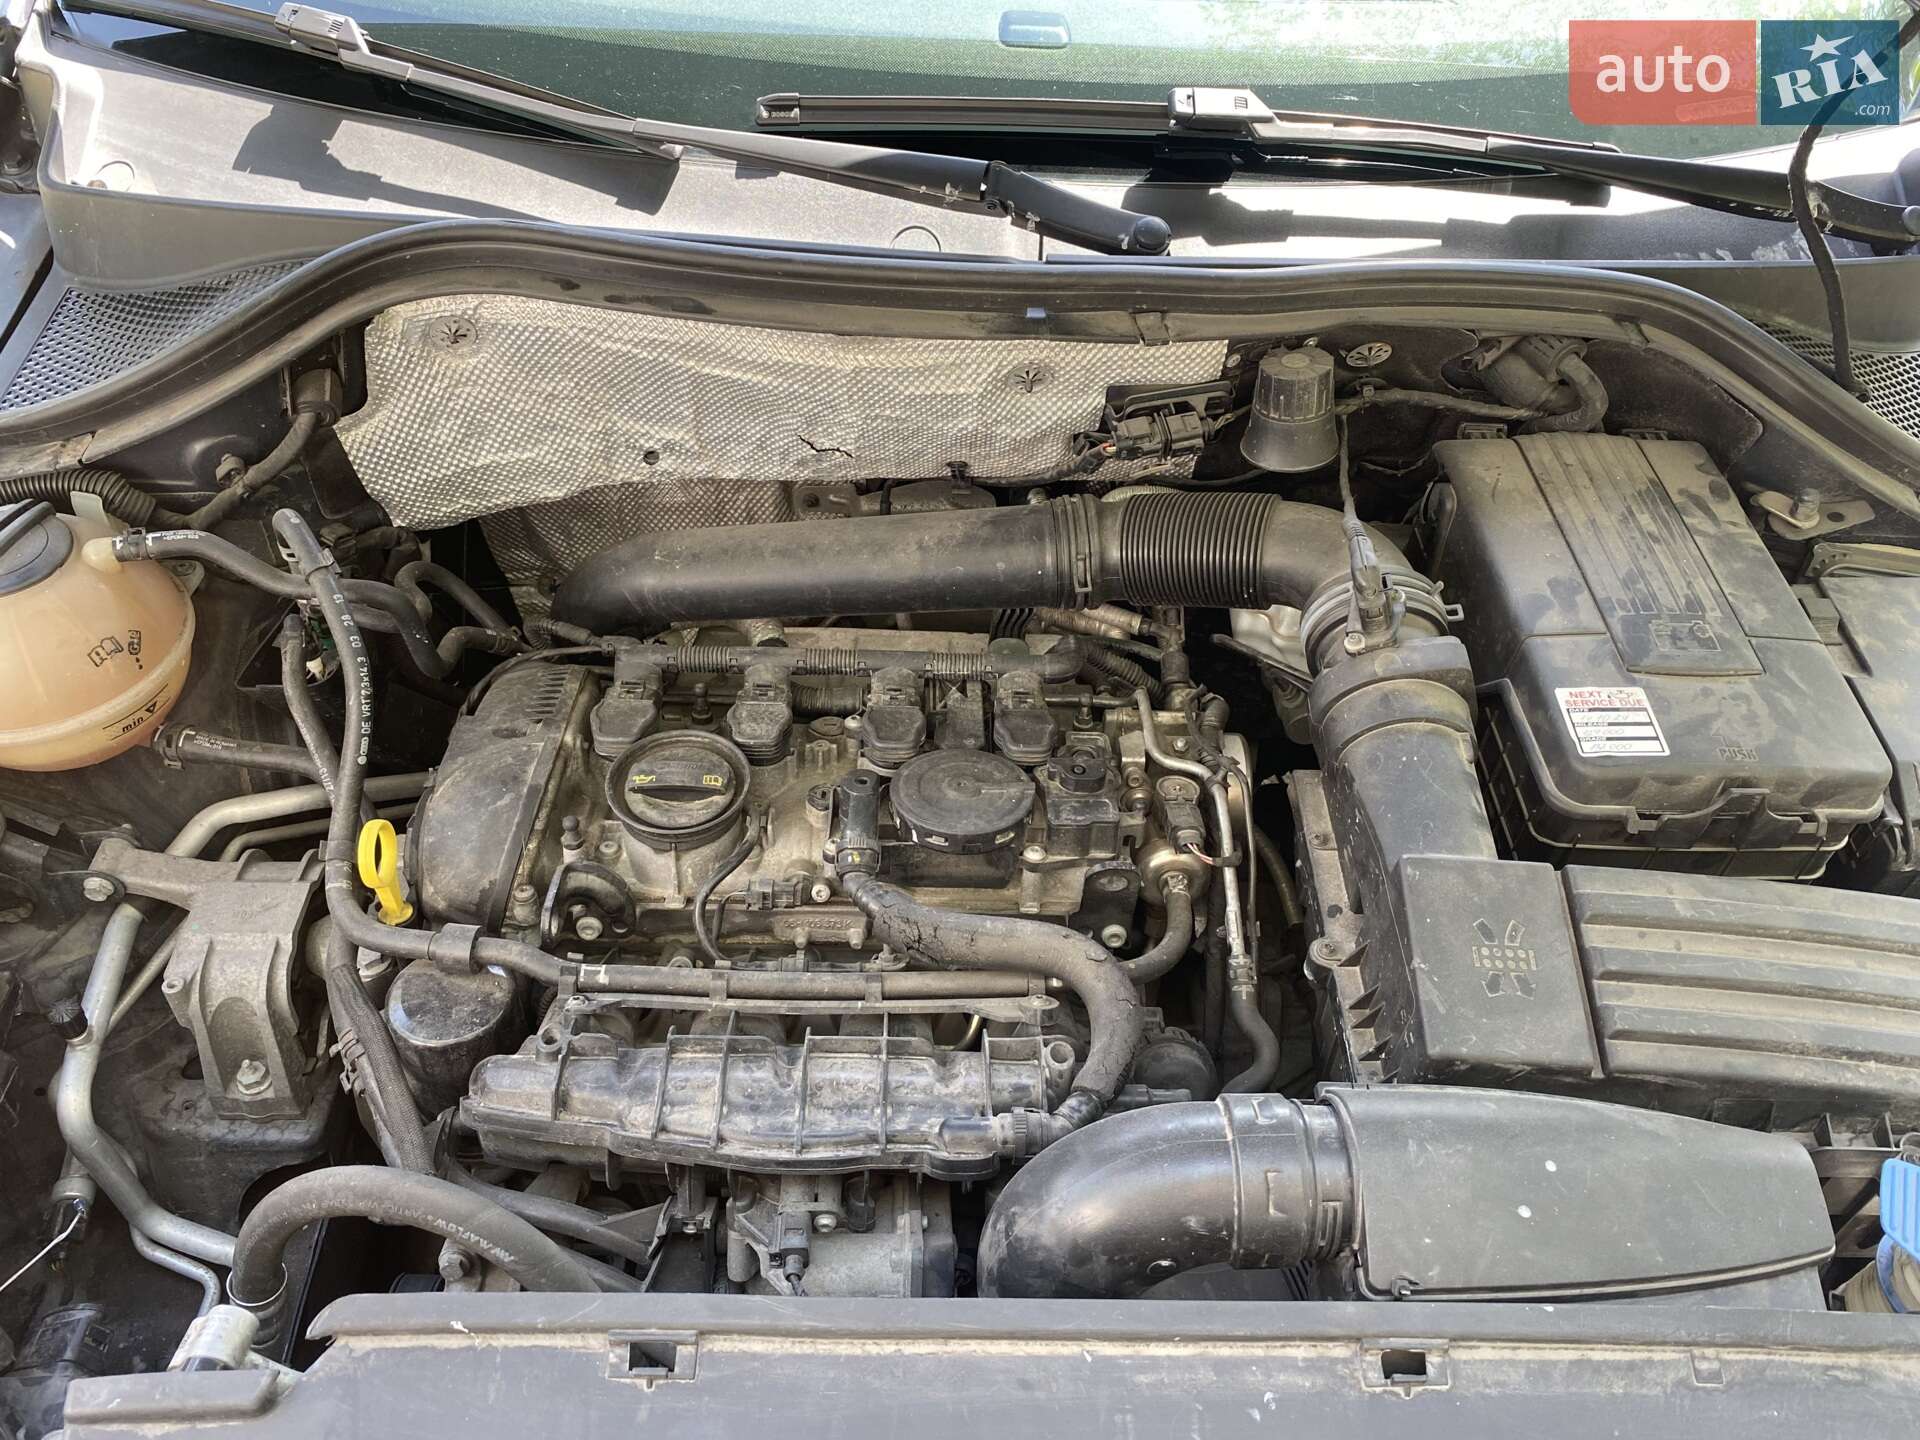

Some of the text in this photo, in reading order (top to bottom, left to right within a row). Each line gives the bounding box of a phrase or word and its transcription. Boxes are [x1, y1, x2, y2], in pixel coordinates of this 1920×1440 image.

[1568, 690, 1602, 699] NEXT
[1564, 699, 1645, 707] SERVICE DUE
[122, 716, 144, 733] min
[1718, 747, 1760, 761] PUSH
